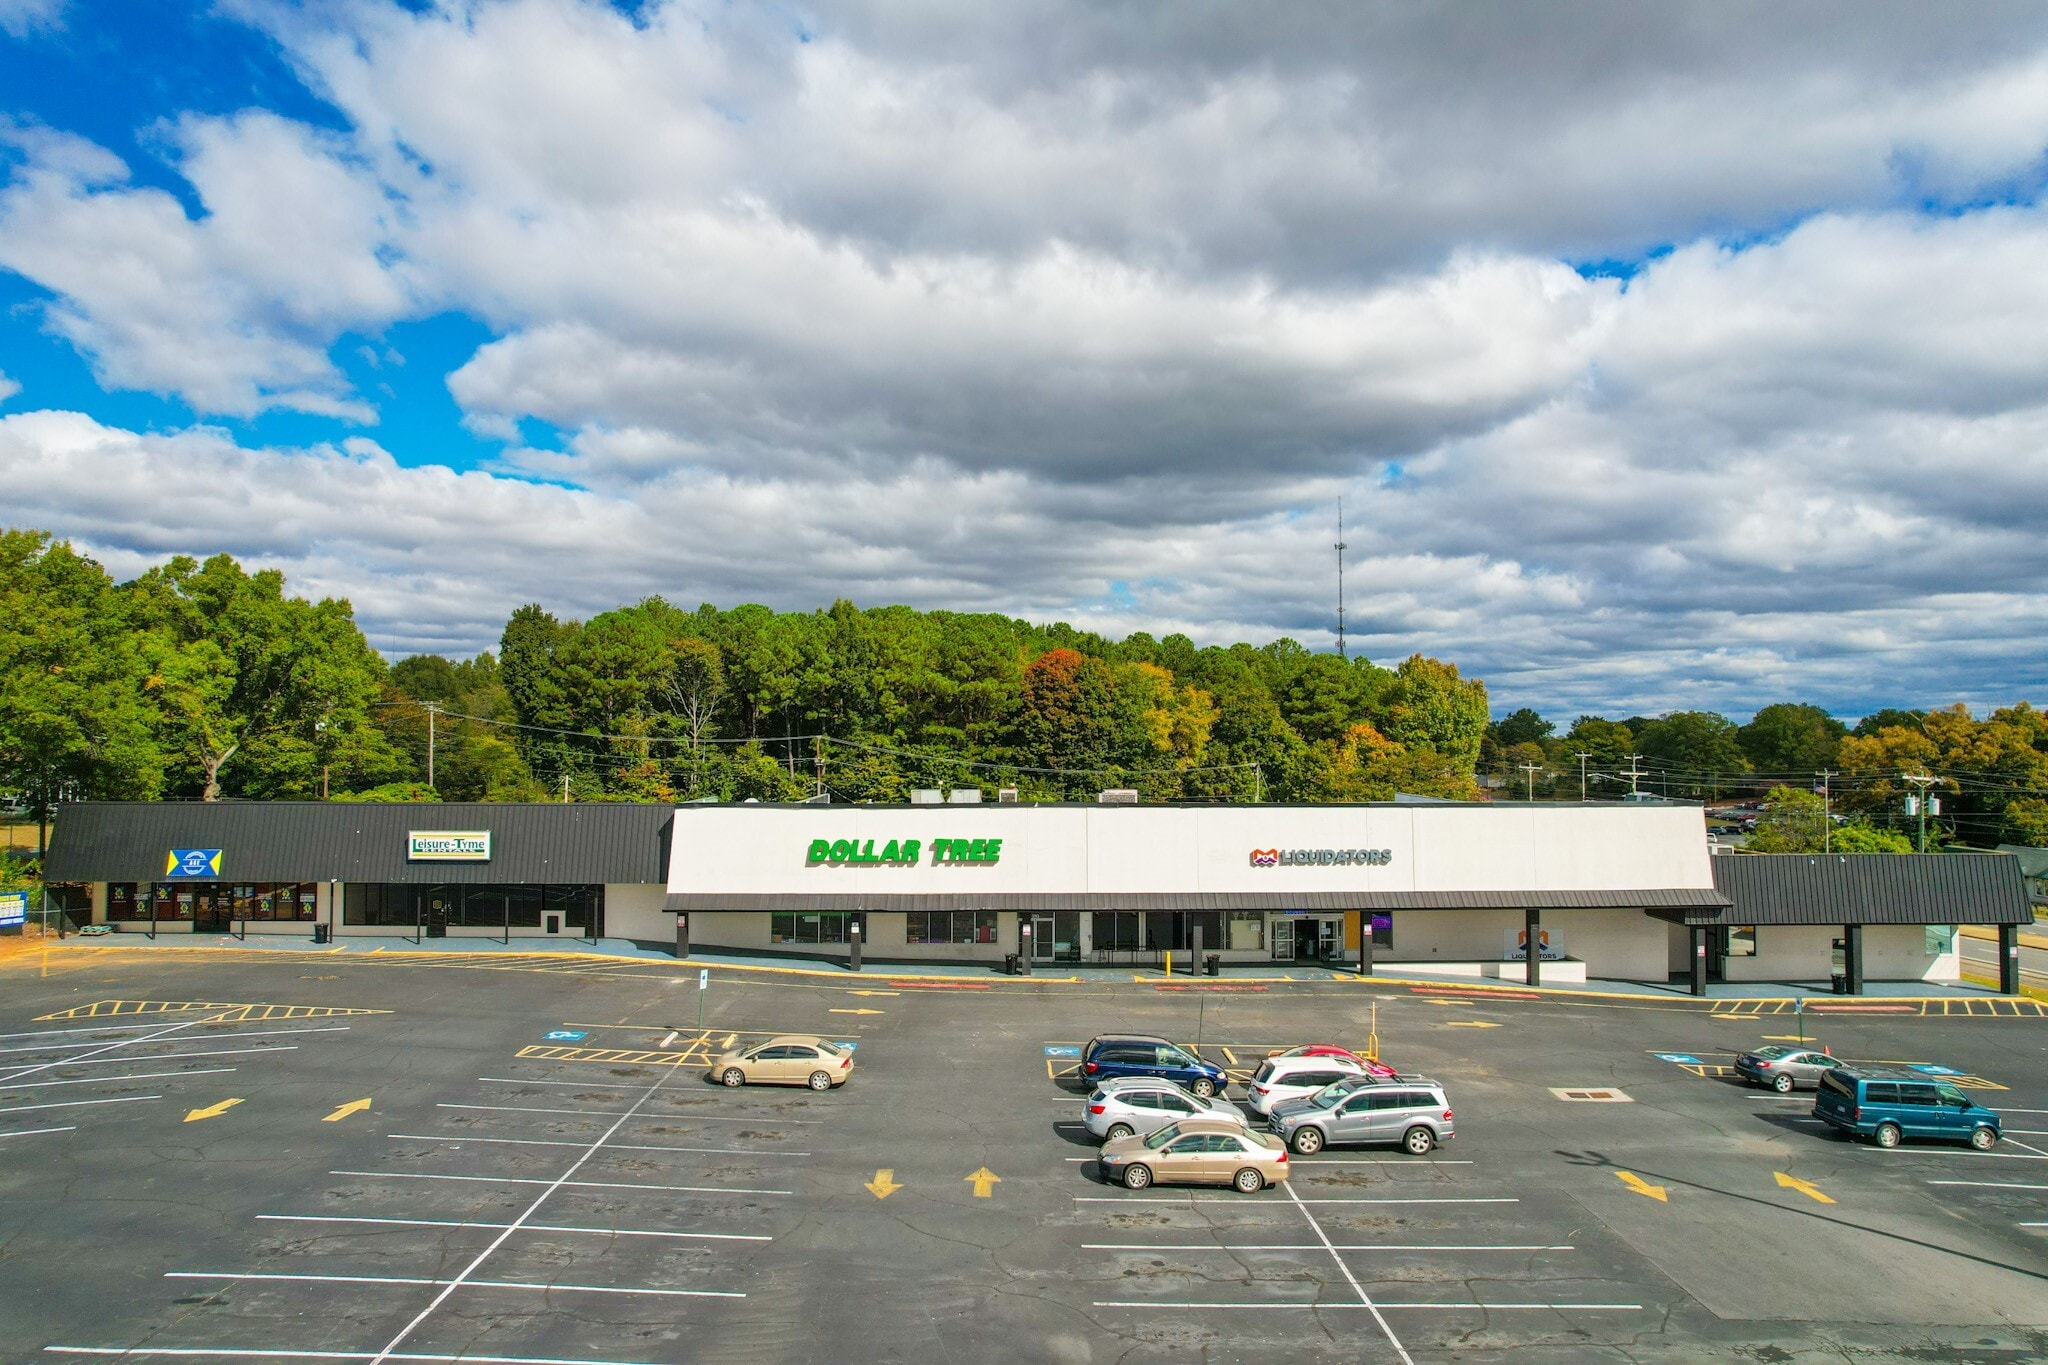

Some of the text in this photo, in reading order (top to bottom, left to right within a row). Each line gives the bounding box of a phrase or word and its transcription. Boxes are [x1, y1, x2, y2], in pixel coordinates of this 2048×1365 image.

[412, 838, 485, 852] Leisure-Tyme
[808, 838, 1003, 862] DOLLAR TREE
[1281, 849, 1392, 863] LIQUIDATORS
